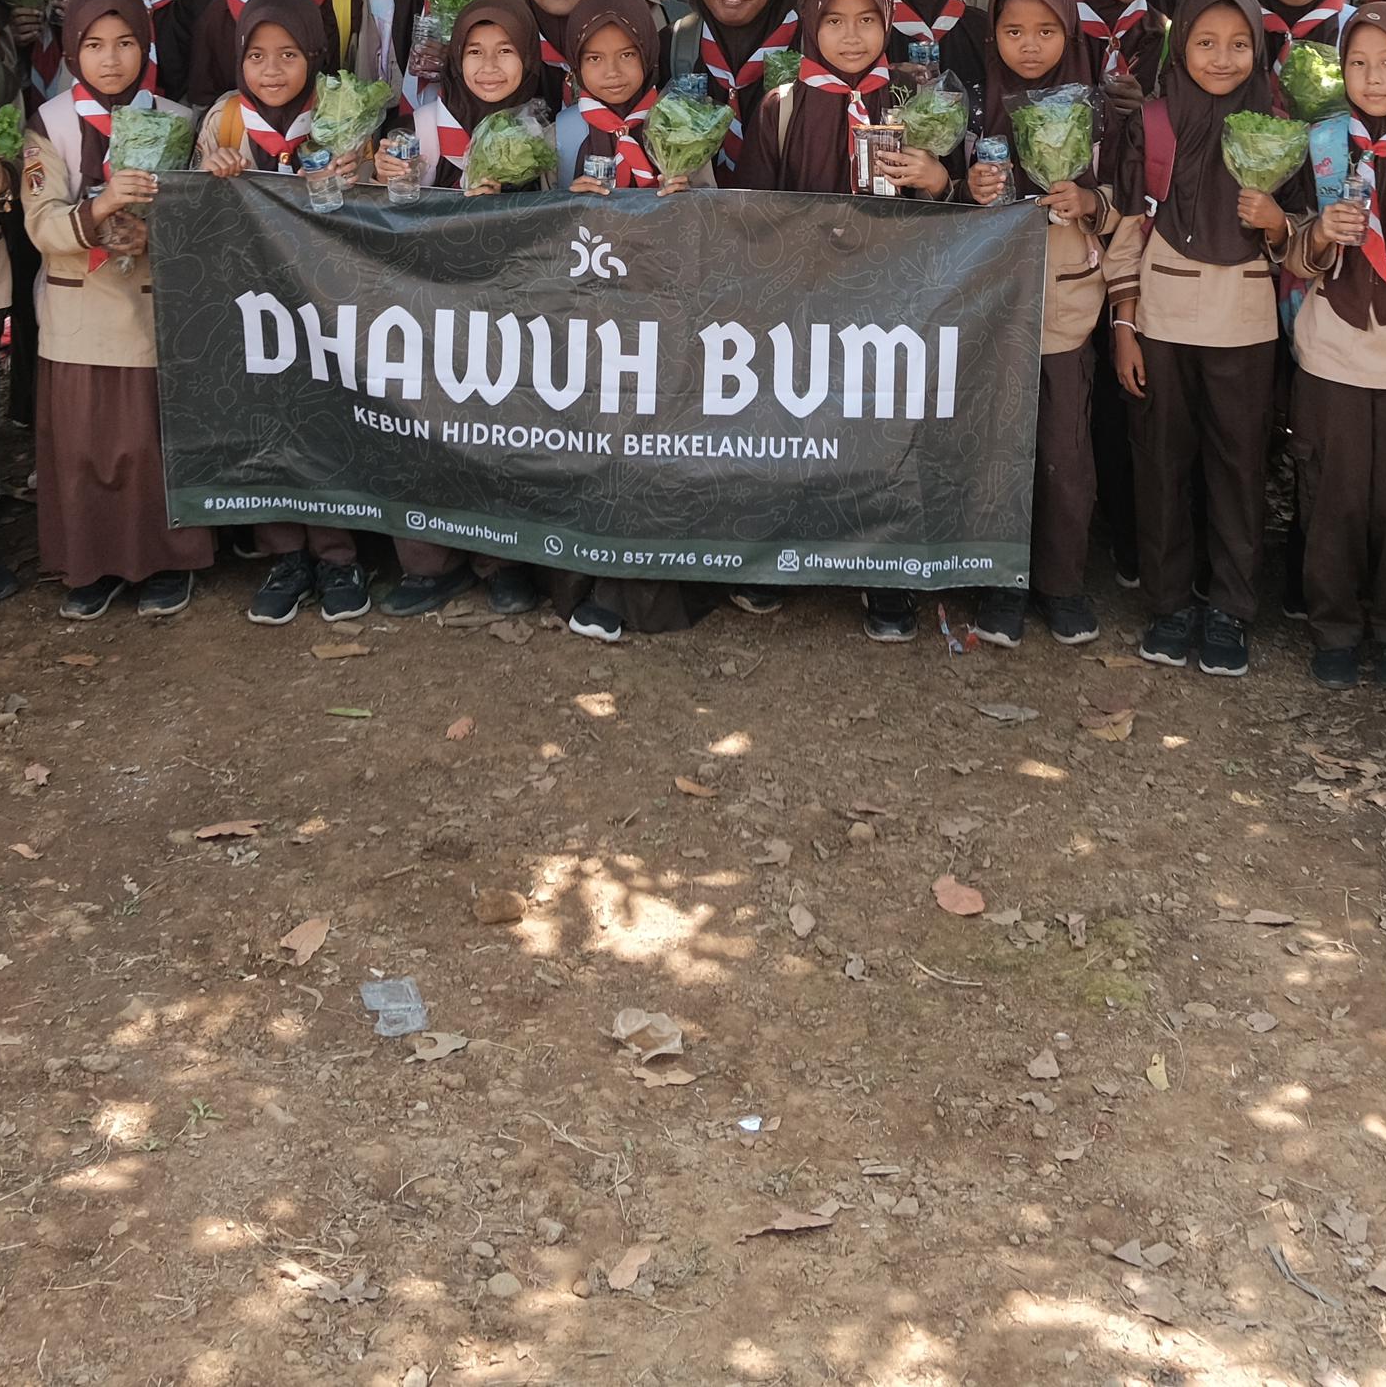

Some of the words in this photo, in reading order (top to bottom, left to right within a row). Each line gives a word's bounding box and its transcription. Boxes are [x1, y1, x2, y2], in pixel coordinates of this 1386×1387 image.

[235, 290, 659, 415] DHAWUH
[698, 321, 959, 420] BUMI
[353, 405, 430, 441] KEBUN
[442, 421, 612, 455] HIDROPONIK
[623, 434, 839, 460] BERKELANJUTAN
[204, 496, 382, 519] #DARIDHAMIUNTUKBUMI
[428, 516, 518, 545] dhawuhbumi
[573, 544, 616, 563] (+62)
[622, 551, 654, 565] 857
[659, 552, 697, 565] 7746
[702, 553, 743, 567] 6470
[804, 553, 993, 578] dhawuhbumi@gmail.com
